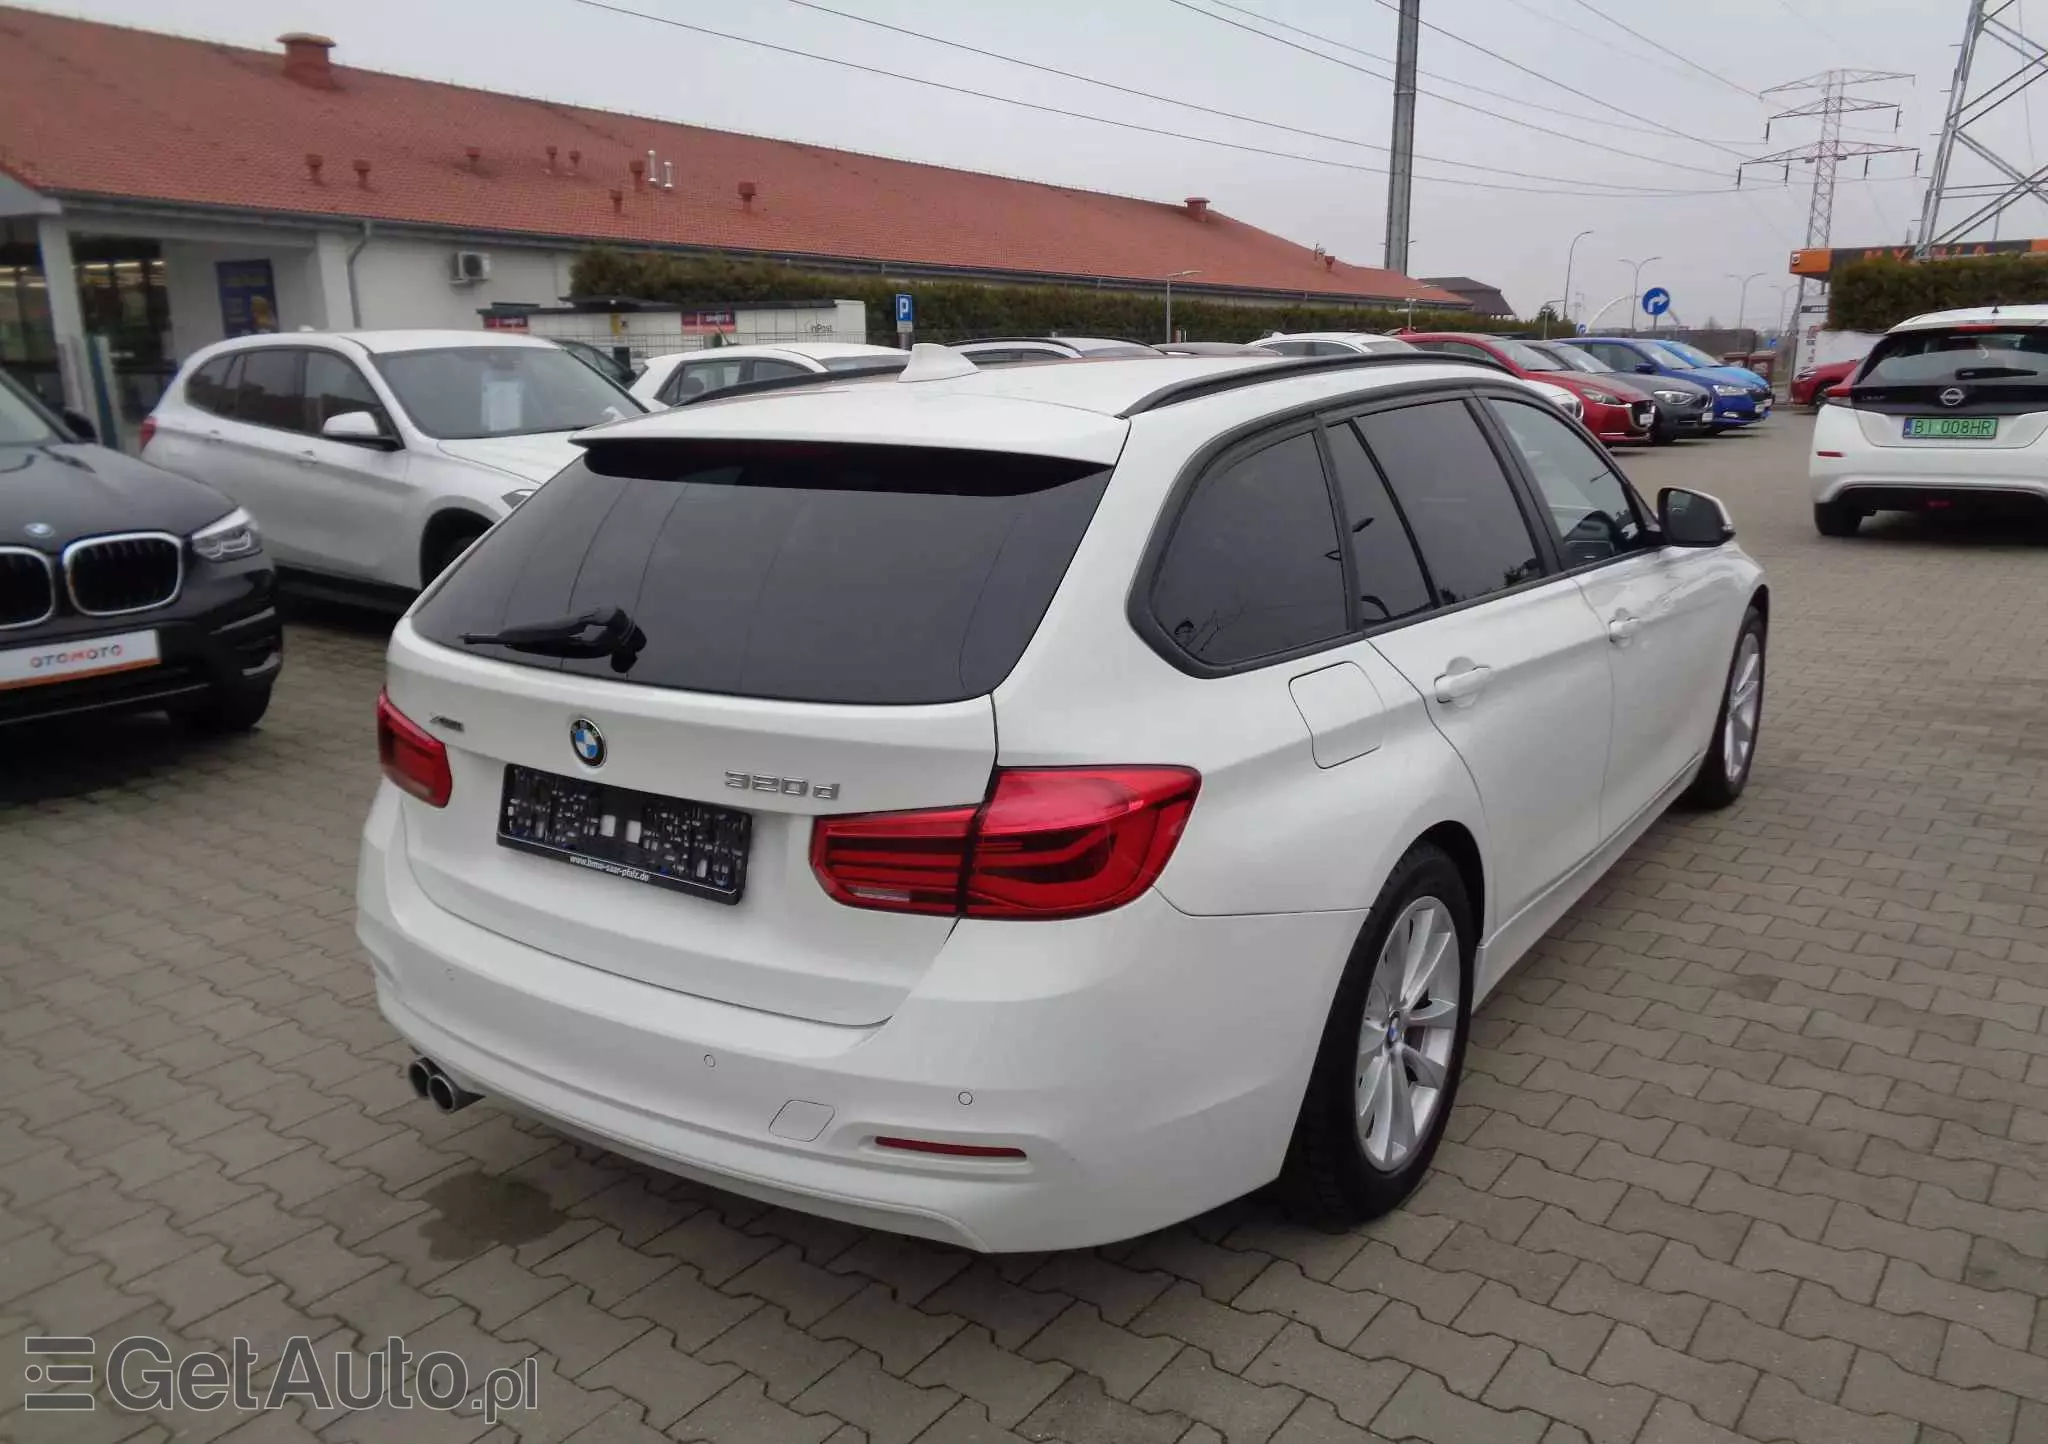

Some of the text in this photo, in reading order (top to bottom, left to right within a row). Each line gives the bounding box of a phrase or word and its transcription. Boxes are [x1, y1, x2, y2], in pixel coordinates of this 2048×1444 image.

[900, 297, 909, 319] P
[1914, 420, 1991, 434] BI 008HR
[30, 644, 123, 669] OTOMOTO
